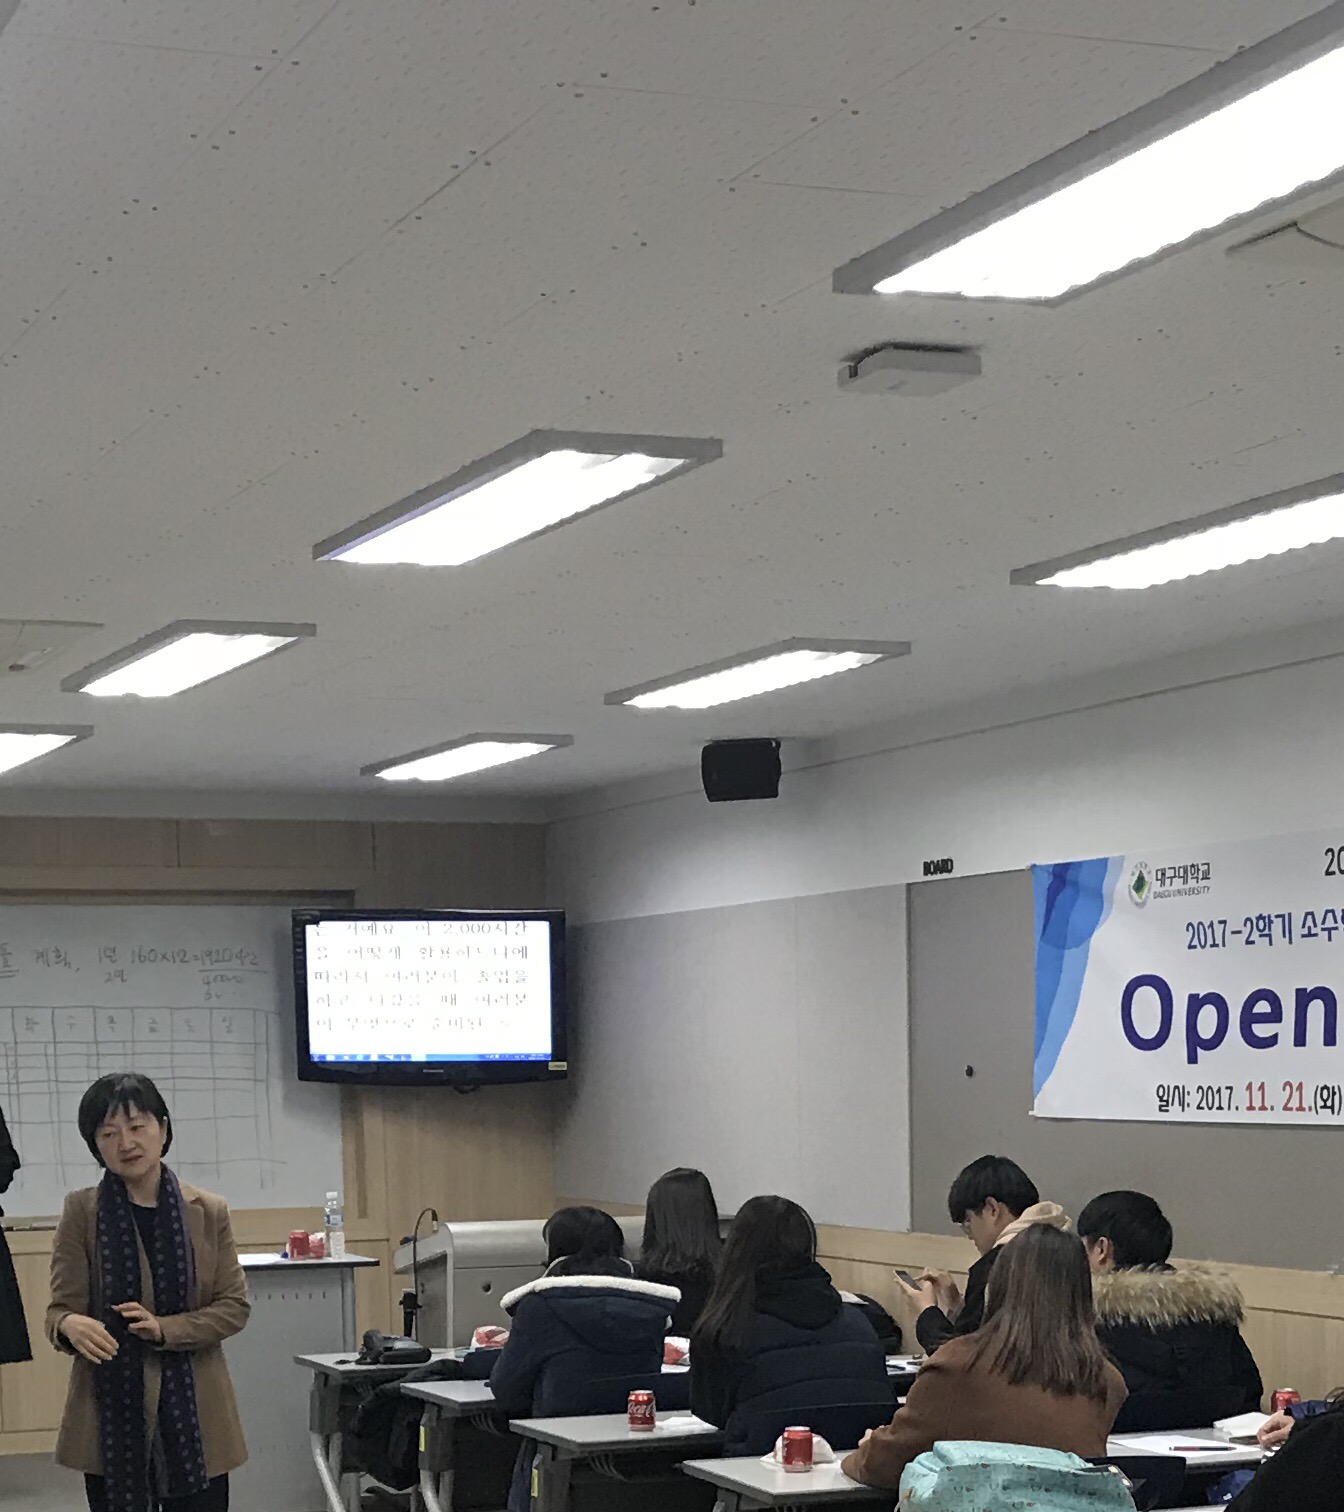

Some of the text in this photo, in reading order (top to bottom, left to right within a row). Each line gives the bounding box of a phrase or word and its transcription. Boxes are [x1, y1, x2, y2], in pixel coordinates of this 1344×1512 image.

[922, 858, 954, 876] BOARD
[1155, 862, 1211, 888] 대구대학교
[1186, 913, 1294, 951] 2017-2학기
[1120, 972, 1339, 1065] Open
[1156, 1084, 1191, 1113] 일시:
[1196, 1085, 1239, 1112] 2017.
[1245, 1082, 1275, 1112] 11.
